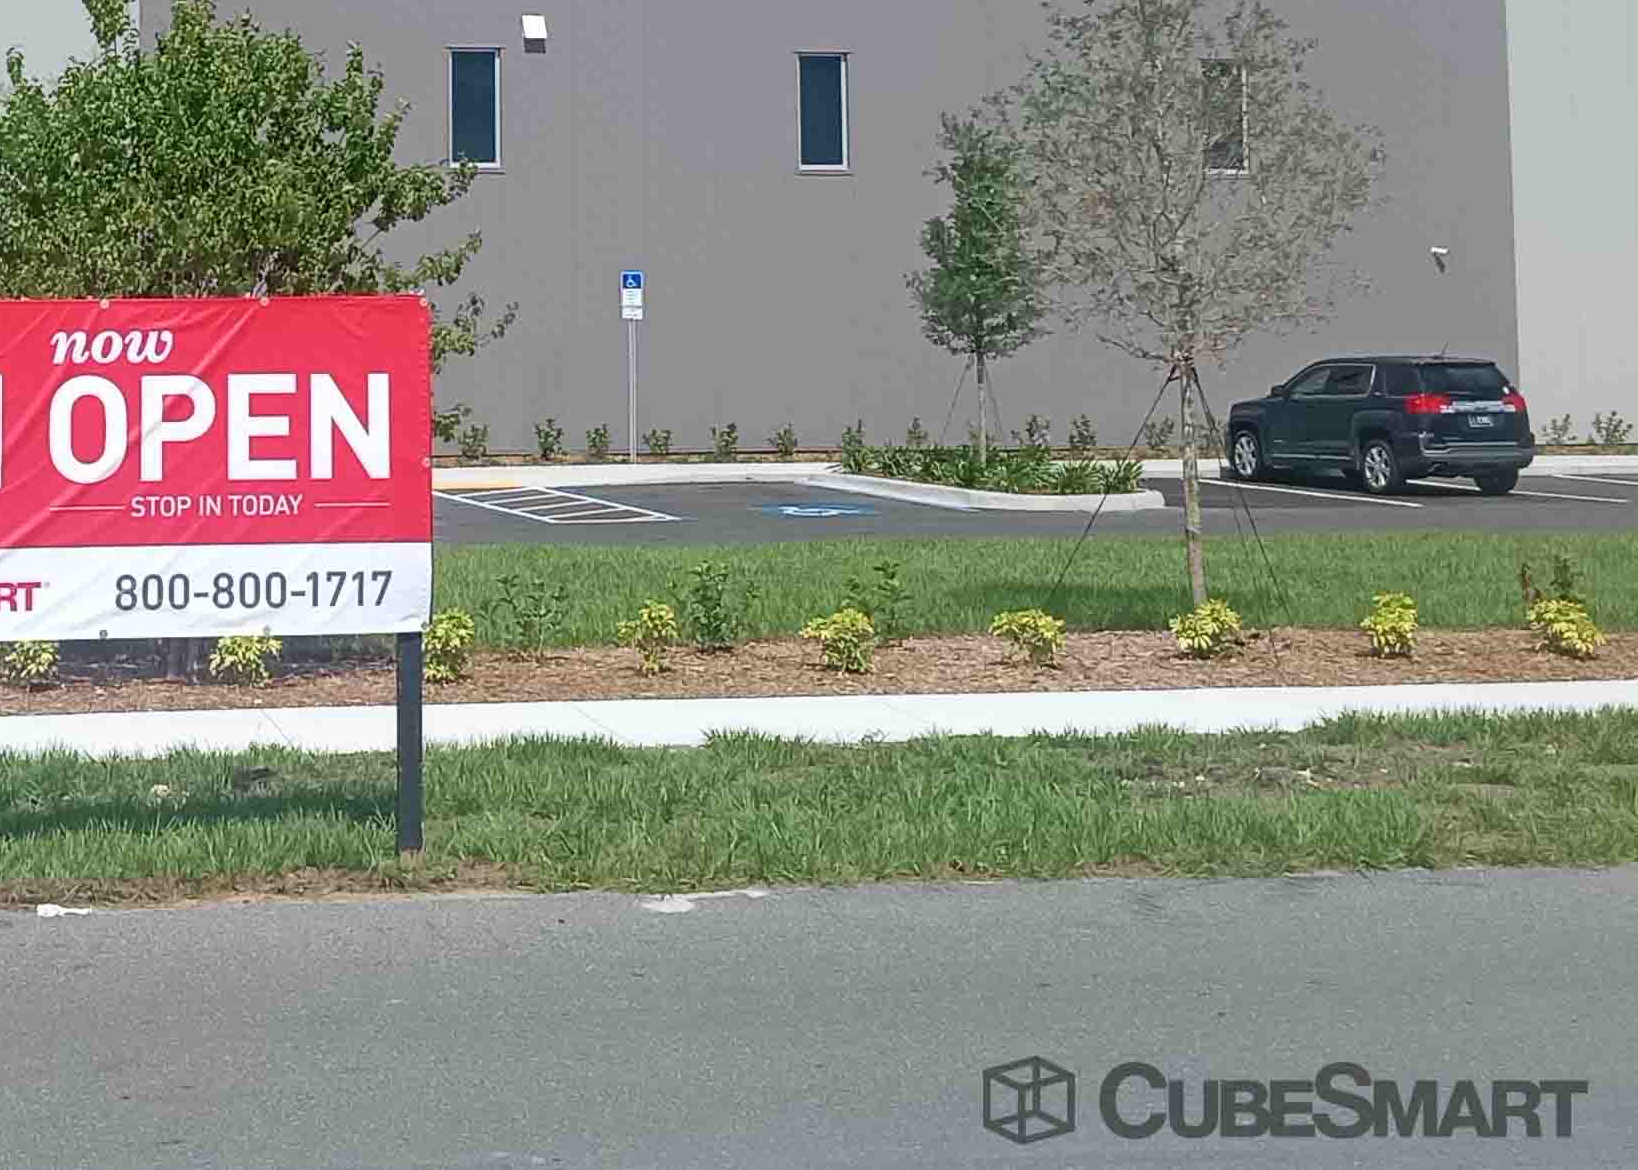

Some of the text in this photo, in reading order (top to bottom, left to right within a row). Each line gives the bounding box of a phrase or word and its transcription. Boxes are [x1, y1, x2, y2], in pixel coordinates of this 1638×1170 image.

[50, 330, 173, 365] now
[49, 373, 391, 484] OPEN
[131, 493, 303, 518] STOP IN TODAY
[115, 570, 392, 611] 800-800-1717
